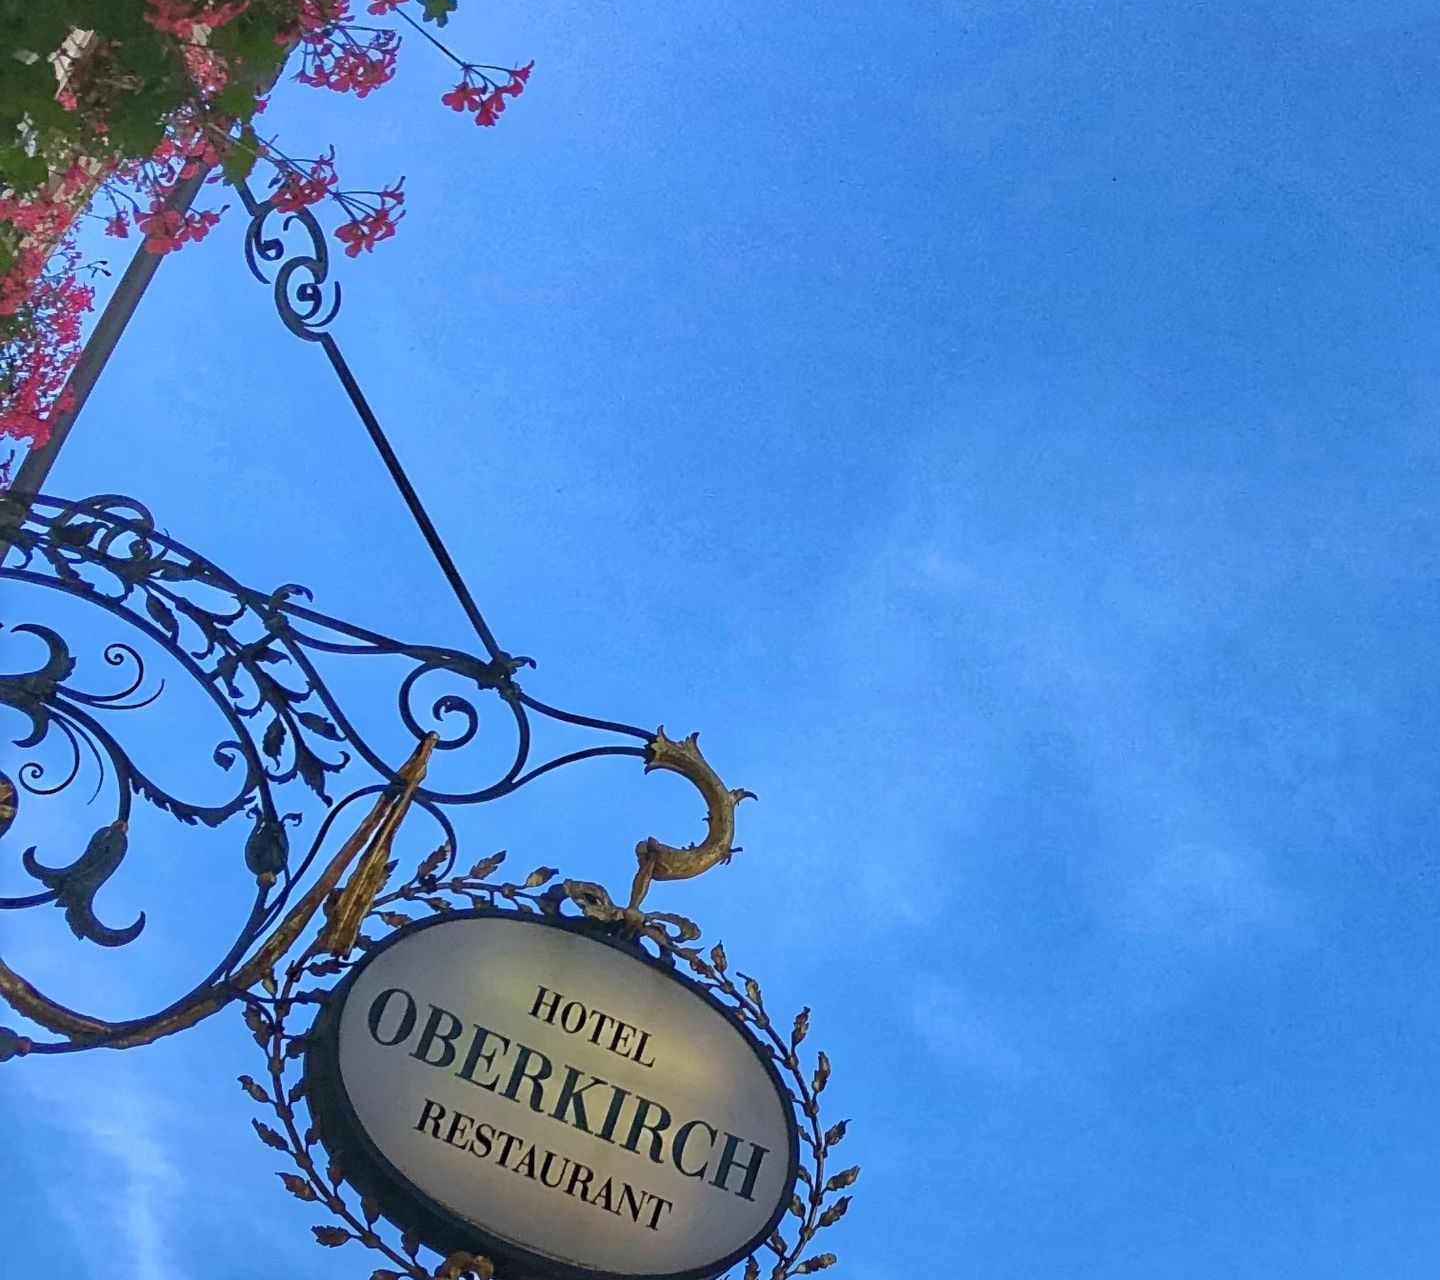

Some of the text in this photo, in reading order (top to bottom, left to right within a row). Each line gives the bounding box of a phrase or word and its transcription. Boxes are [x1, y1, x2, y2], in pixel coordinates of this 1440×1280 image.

[528, 985, 655, 1068] HOTEL
[368, 988, 770, 1202] OBERKIRCH
[413, 1098, 673, 1231] RESTAURANT
